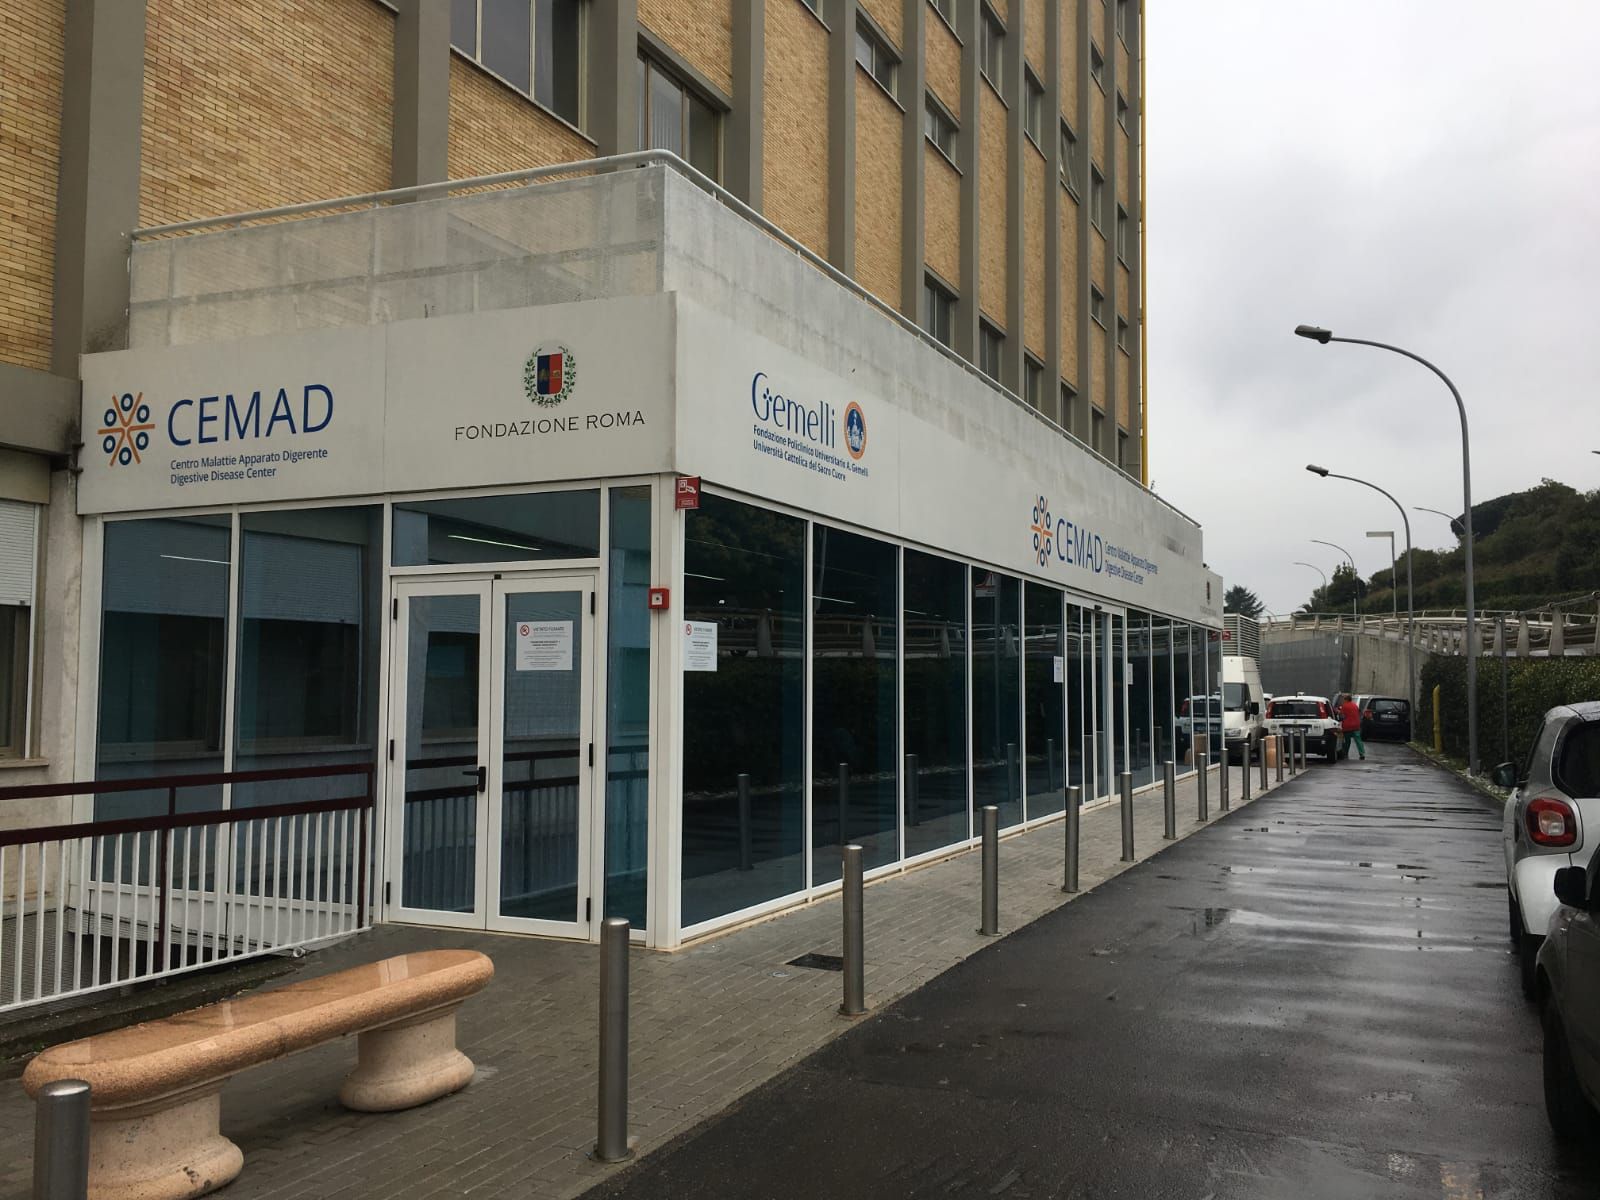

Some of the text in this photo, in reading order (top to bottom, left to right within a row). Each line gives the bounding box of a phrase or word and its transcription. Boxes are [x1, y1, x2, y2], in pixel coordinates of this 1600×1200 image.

[167, 383, 334, 447] CEMAD
[455, 410, 646, 441] FONDAZIONE ROMA
[751, 371, 835, 449] Gemelli
[170, 448, 328, 470] Centro Malattie Apparato Digerente
[753, 424, 787, 446] Fondazione
[787, 437, 814, 457] Policlinico
[815, 448, 846, 469] Universitario
[852, 463, 869, 478] Gemelli
[753, 439, 846, 482] Università Cattolica del Sacro Cuore
[170, 467, 277, 487] Digestive Disease Center
[1056, 518, 1103, 573] CEMAD
